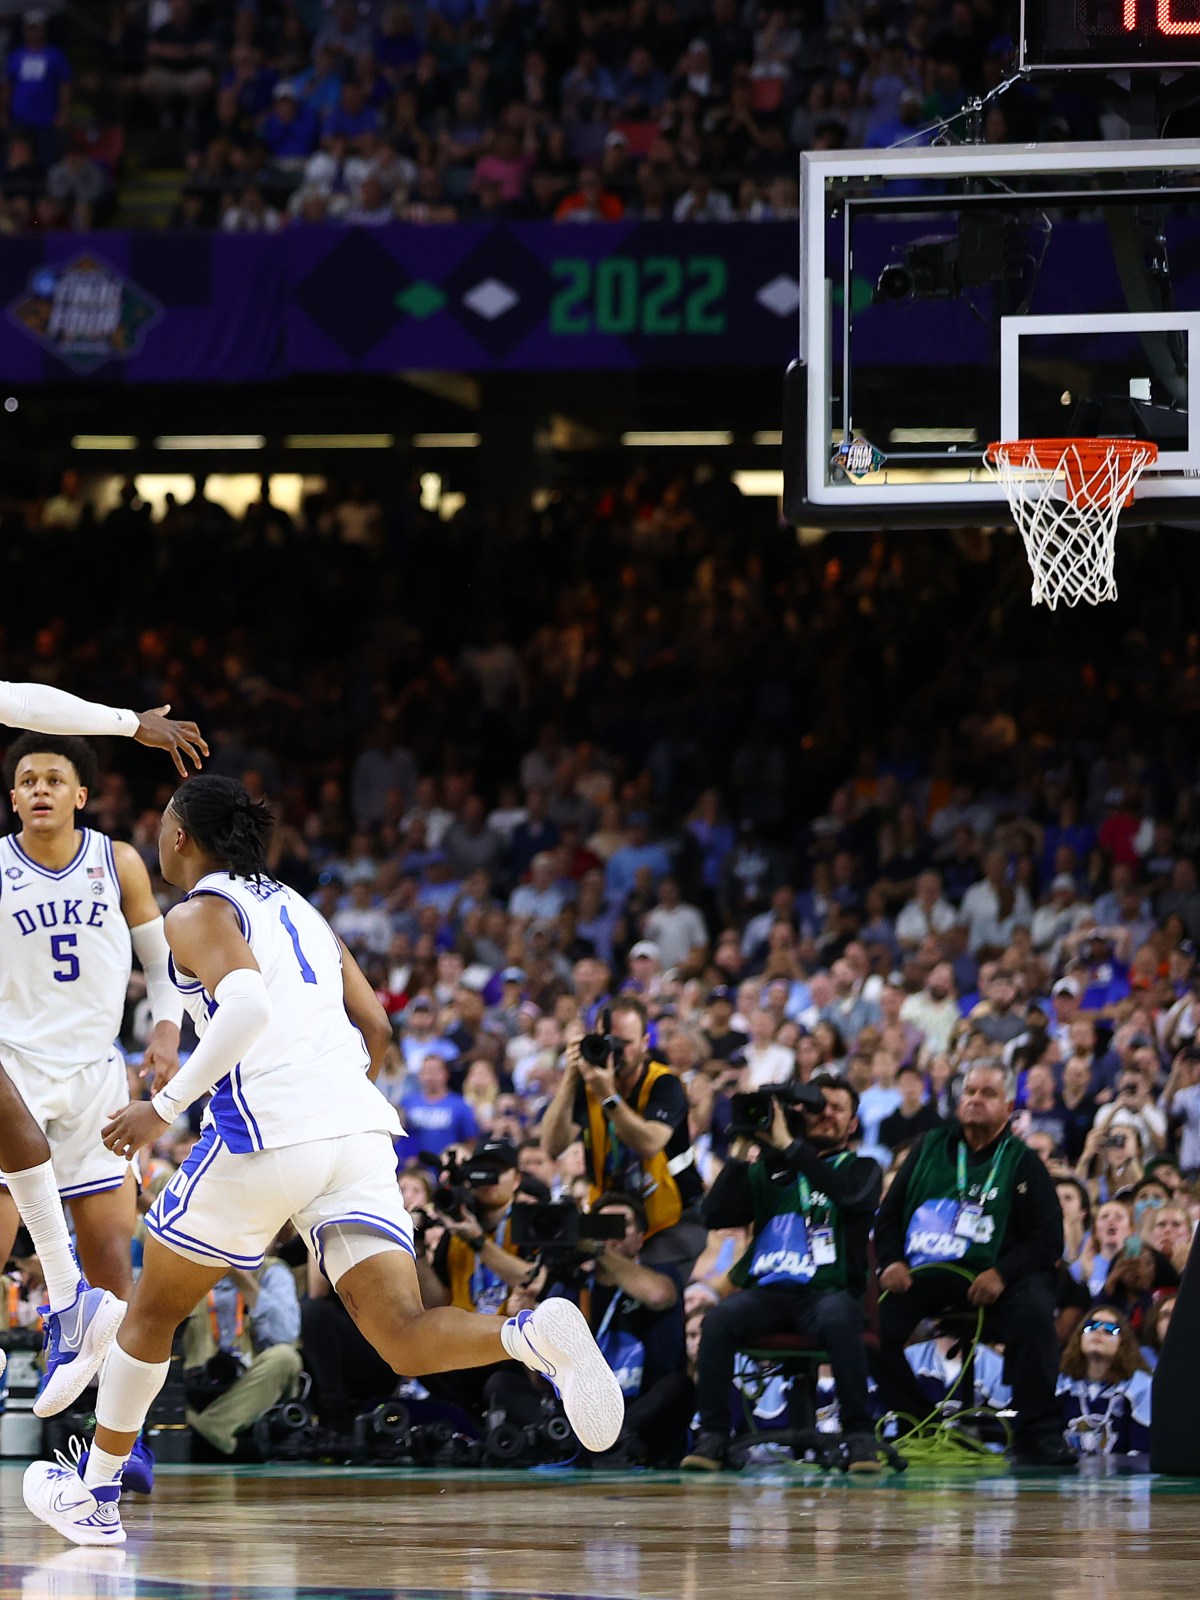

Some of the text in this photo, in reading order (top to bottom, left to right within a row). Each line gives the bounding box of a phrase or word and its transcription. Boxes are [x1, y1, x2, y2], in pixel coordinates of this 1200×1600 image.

[550, 257, 728, 335] 2022
[12, 899, 108, 936] DUKE
[50, 933, 80, 982] 5
[279, 904, 317, 985] 1
[907, 1230, 970, 1259] NCAA
